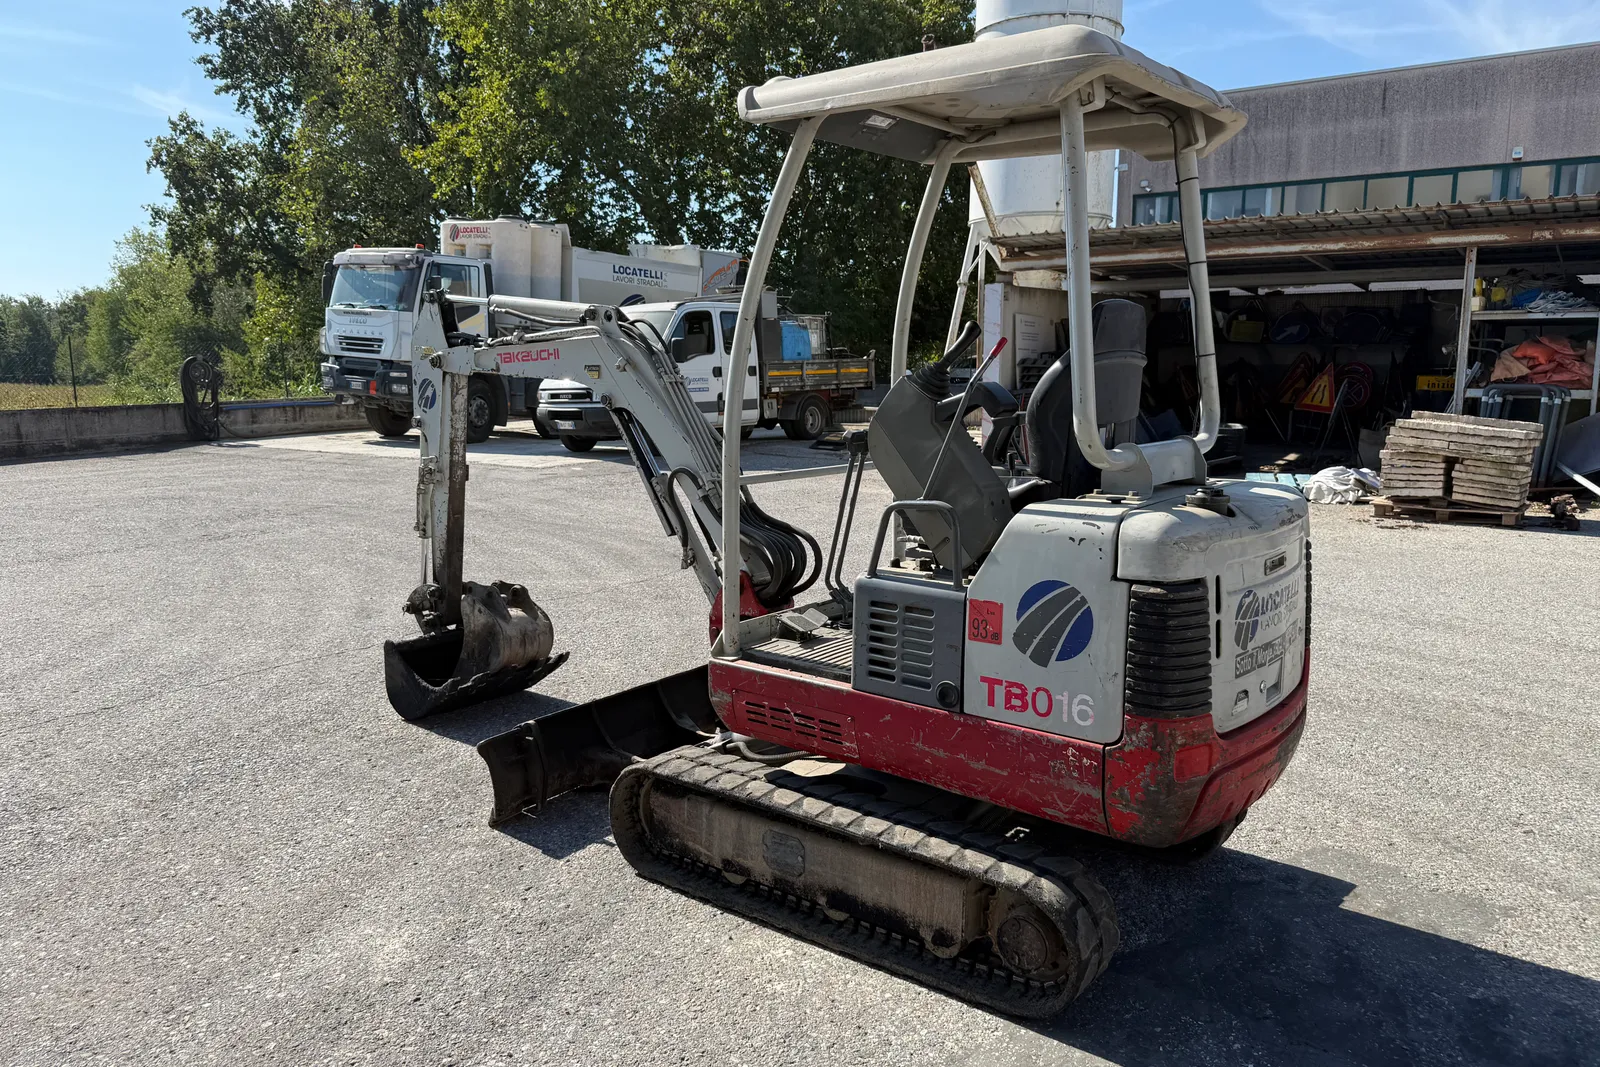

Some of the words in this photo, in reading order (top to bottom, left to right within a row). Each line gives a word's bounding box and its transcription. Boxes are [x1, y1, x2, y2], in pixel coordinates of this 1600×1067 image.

[612, 264, 663, 280] LOCATELLI
[612, 274, 635, 284] LAVORI
[496, 348, 560, 364] TAKEUCHI
[972, 617, 988, 640] 93
[990, 632, 1000, 641] dB
[979, 675, 1095, 727] TB016
